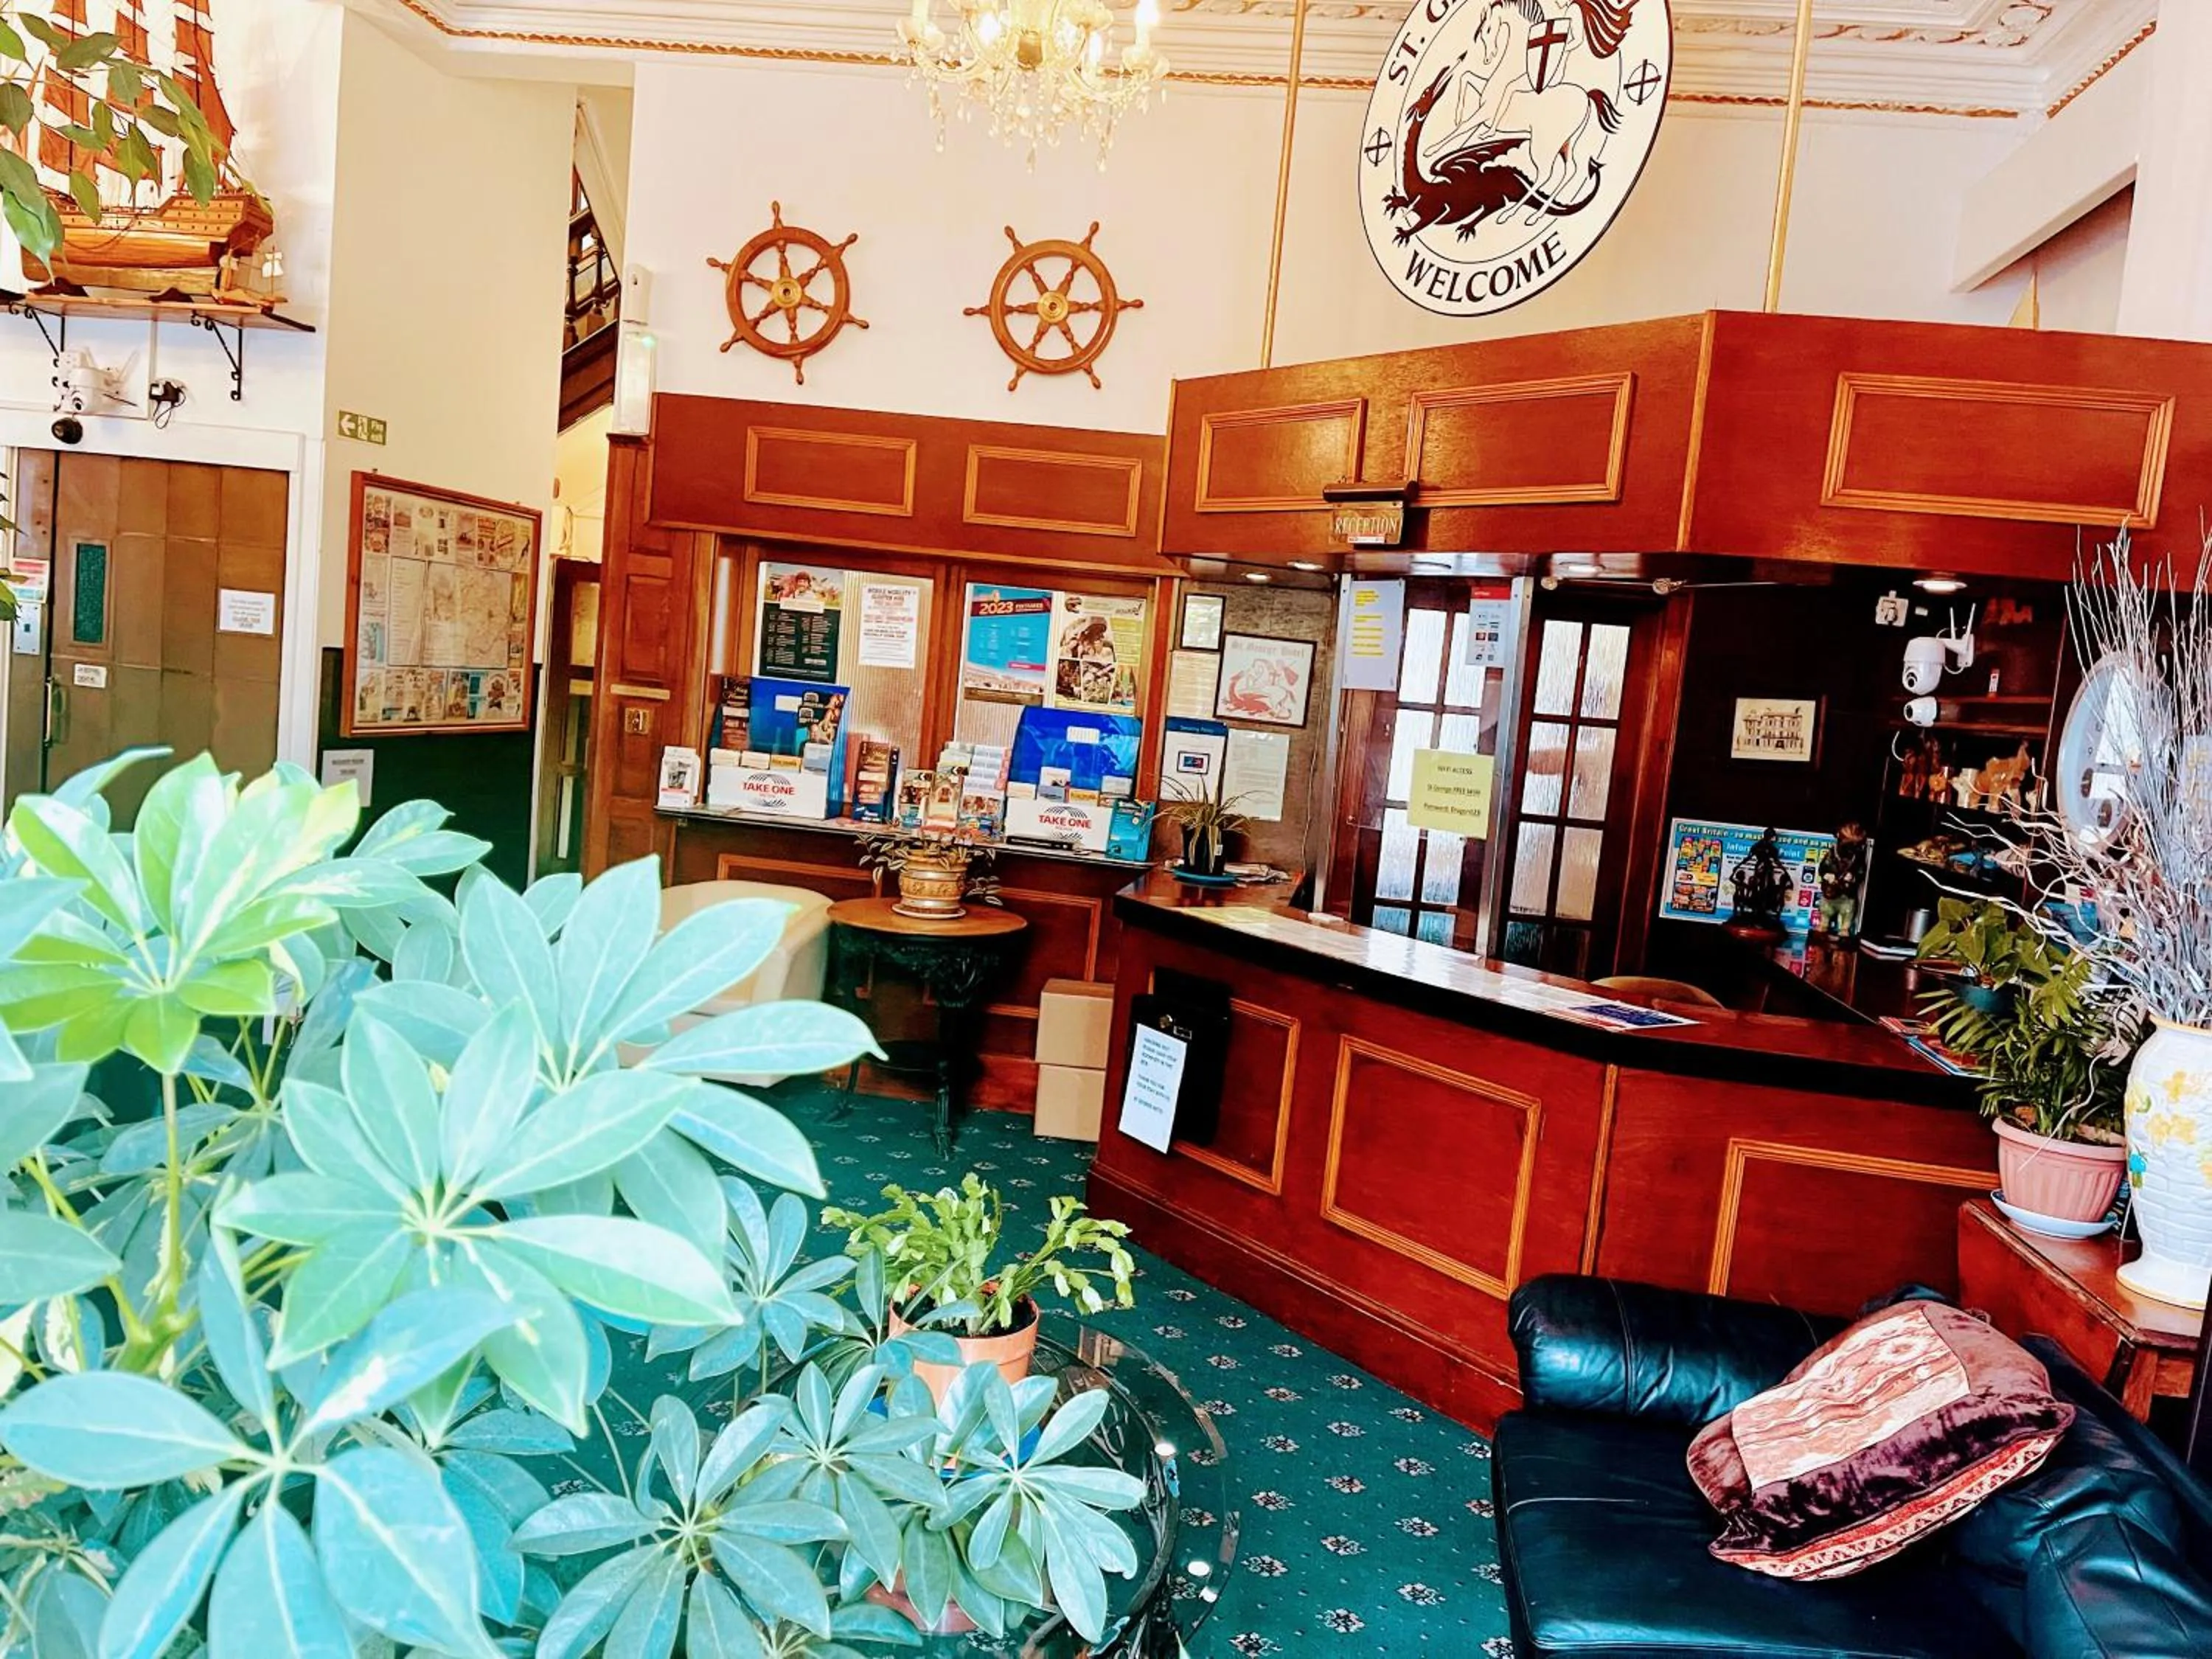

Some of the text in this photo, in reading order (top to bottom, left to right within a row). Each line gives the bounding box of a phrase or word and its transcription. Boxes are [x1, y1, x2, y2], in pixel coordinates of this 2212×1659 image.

[1388, 32, 1425, 86] ST.
[1405, 231, 1568, 304] WELCOME
[1334, 516, 1397, 535] RECEPTION
[979, 602, 1013, 615] 2023
[743, 782, 795, 796] TAKE ONE
[1038, 815, 1092, 829] TAKE ONE
